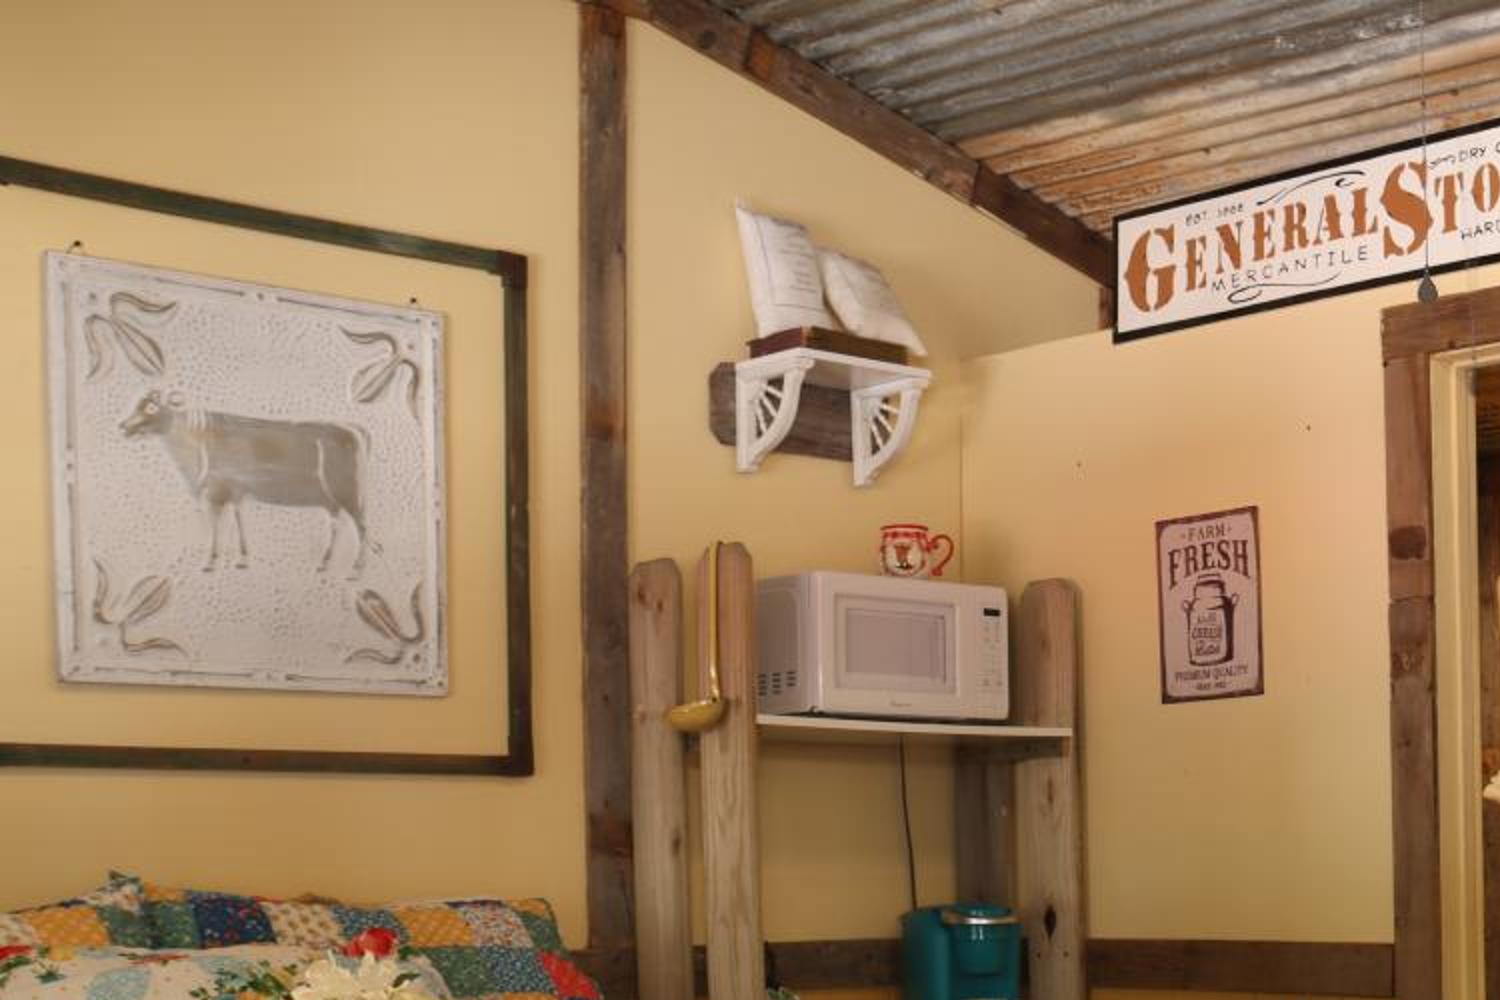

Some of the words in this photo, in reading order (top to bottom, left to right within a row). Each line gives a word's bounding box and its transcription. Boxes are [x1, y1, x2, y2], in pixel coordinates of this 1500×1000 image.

[1458, 146, 1486, 163] DRY
[1123, 186, 1379, 313] GENERAL
[1211, 244, 1370, 294] MERCANTILE
[1187, 521, 1226, 542] FARM
[1168, 538, 1251, 591] FRESH
